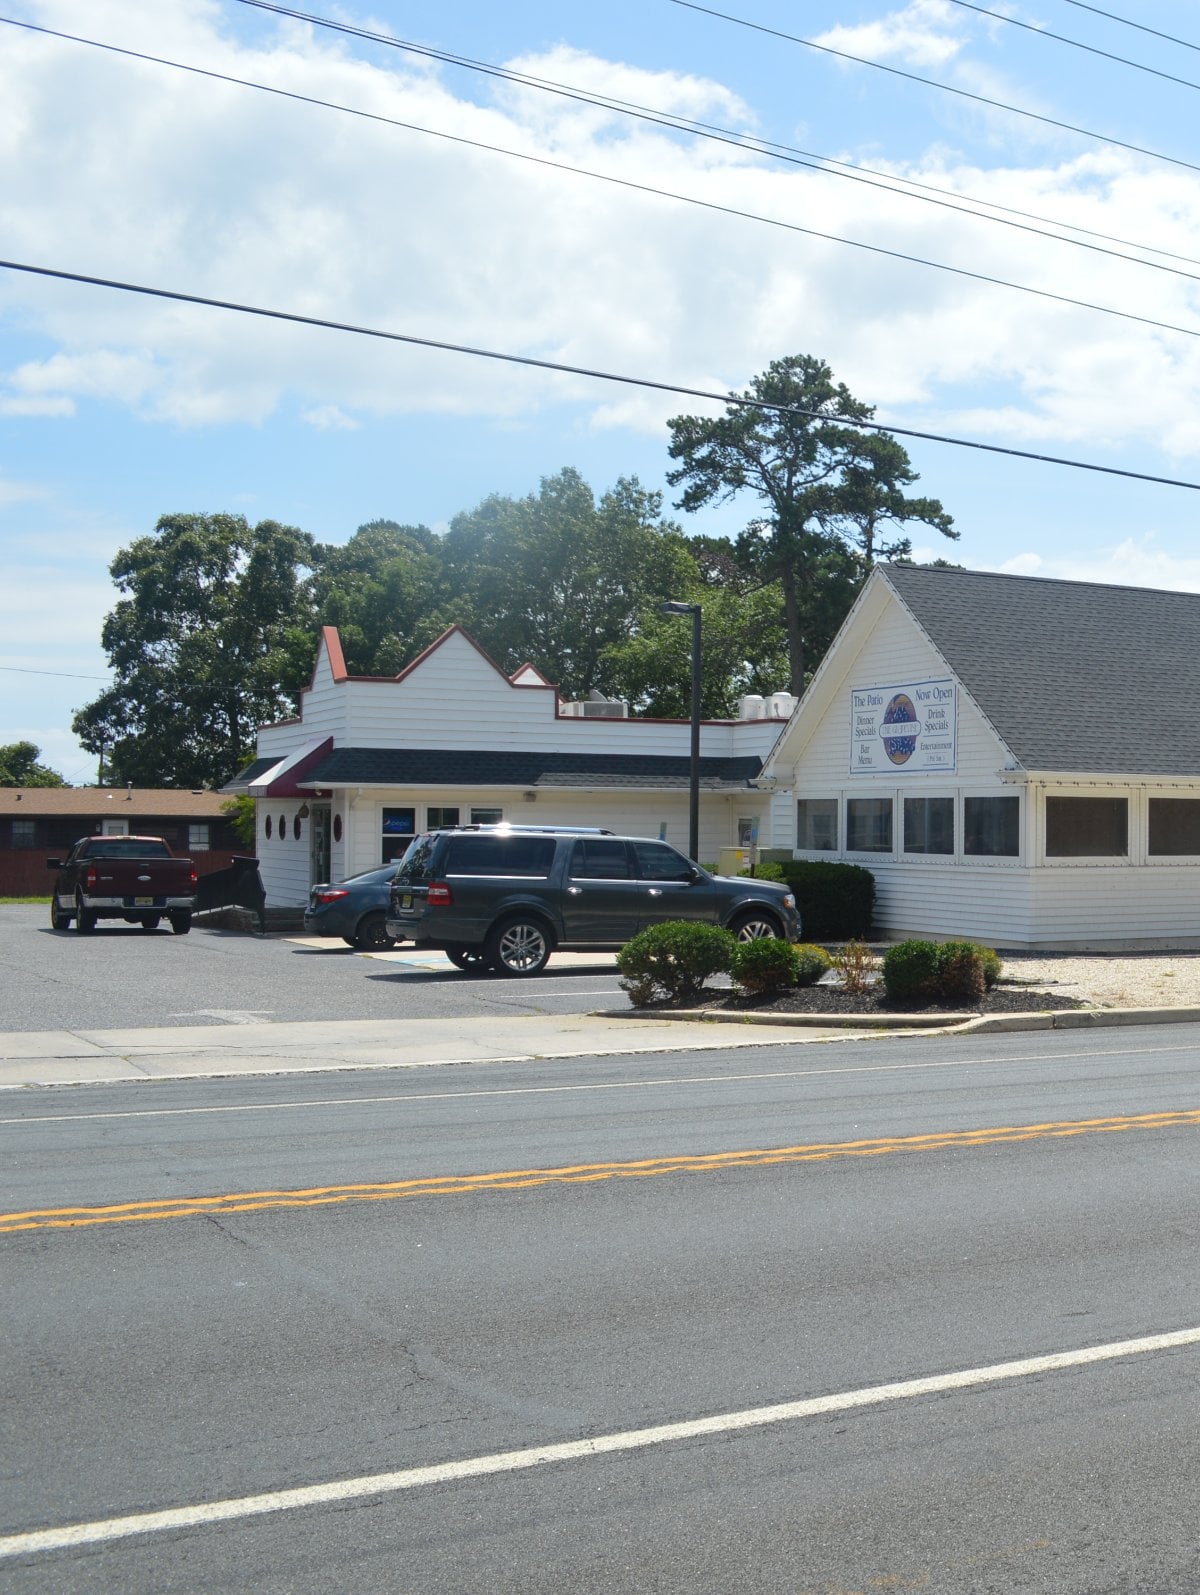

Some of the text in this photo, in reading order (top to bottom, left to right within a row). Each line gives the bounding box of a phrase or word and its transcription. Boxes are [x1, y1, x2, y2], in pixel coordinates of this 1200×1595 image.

[915, 687, 953, 701] Now Open
[854, 694, 884, 707] The Patio
[928, 709, 946, 720] Drink
[856, 716, 875, 726] Dinner
[924, 720, 950, 733] Specials
[855, 727, 877, 738] Specials
[860, 744, 870, 754] Bar
[920, 742, 953, 751] Entertainment
[858, 756, 873, 765] Menu
